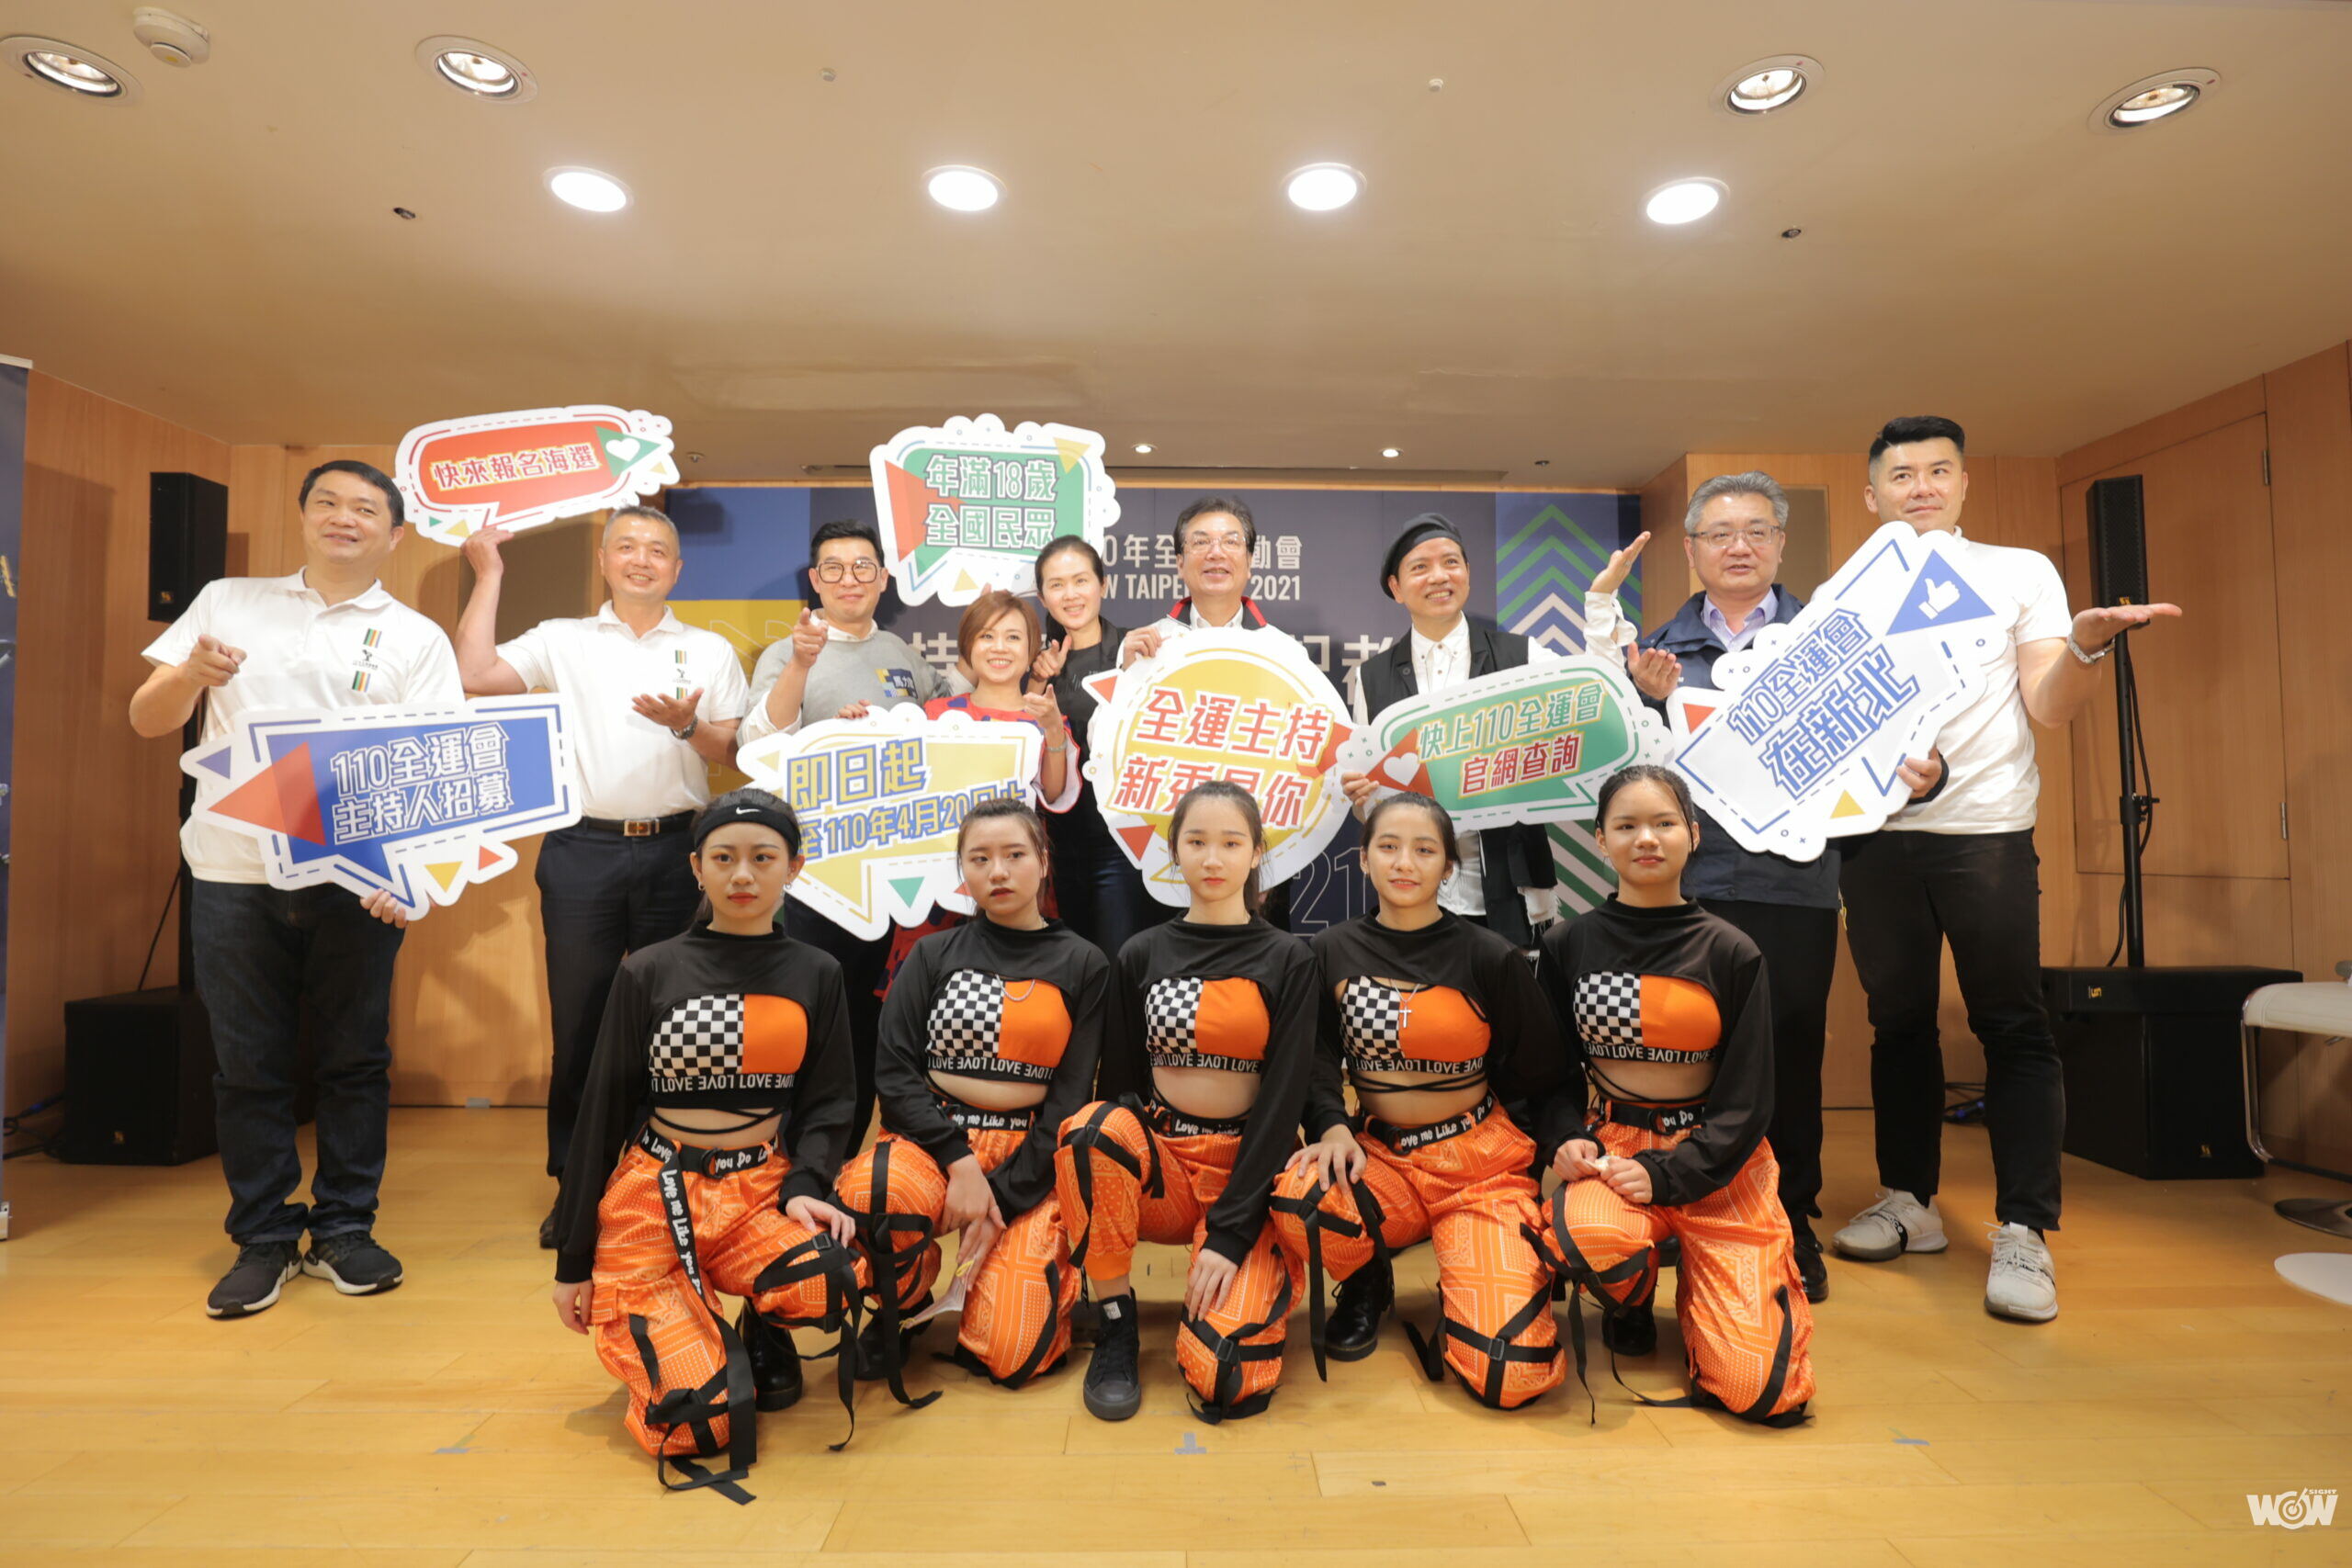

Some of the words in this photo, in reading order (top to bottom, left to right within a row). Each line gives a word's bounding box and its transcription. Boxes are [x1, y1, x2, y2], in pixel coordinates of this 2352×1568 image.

[432, 445, 599, 491] 快來報名海選
[925, 455, 1058, 502] 年滿18歲
[924, 502, 1057, 550] 全國民眾
[1250, 575, 1301, 600] 2021
[1727, 608, 1872, 746] 110全運會
[1136, 689, 1329, 761] 全運主持
[1419, 682, 1605, 761] 快上110全運會
[1758, 643, 1921, 800] 在新北
[330, 722, 510, 797] 110全運會
[787, 738, 926, 813] 即日起
[1461, 732, 1580, 795] 官網查詢
[332, 768, 514, 845] 主持人招募
[933, 1056, 954, 1069] LOVE
[956, 1057, 988, 1070] LOVE
[990, 1058, 1022, 1077] LOVE
[1169, 1053, 1193, 1066] LOVE
[1197, 1054, 1228, 1071] LOVE
[1387, 1059, 1420, 1072] LOVE
[1427, 1061, 1460, 1074] LOVE
[1612, 1044, 1645, 1059] LOVE
[1648, 1047, 1680, 1063] LOVE
[662, 1076, 693, 1092] LOVE
[698, 1074, 734, 1090] LOVE
[740, 1073, 773, 1089] LOVE
[982, 1114, 1005, 1127] Like
[1011, 1117, 1028, 1130] you
[1175, 1119, 1200, 1134] Love
[1400, 1135, 1419, 1147] ove
[1434, 1122, 1458, 1140] Like
[1662, 1118, 1677, 1129] ou
[1679, 1110, 1694, 1126] Do
[650, 1137, 673, 1164] Love
[715, 1156, 733, 1174] you
[737, 1151, 752, 1168] Do
[662, 1168, 678, 1200] Love
[672, 1217, 690, 1247] Like
[680, 1250, 695, 1275] you
